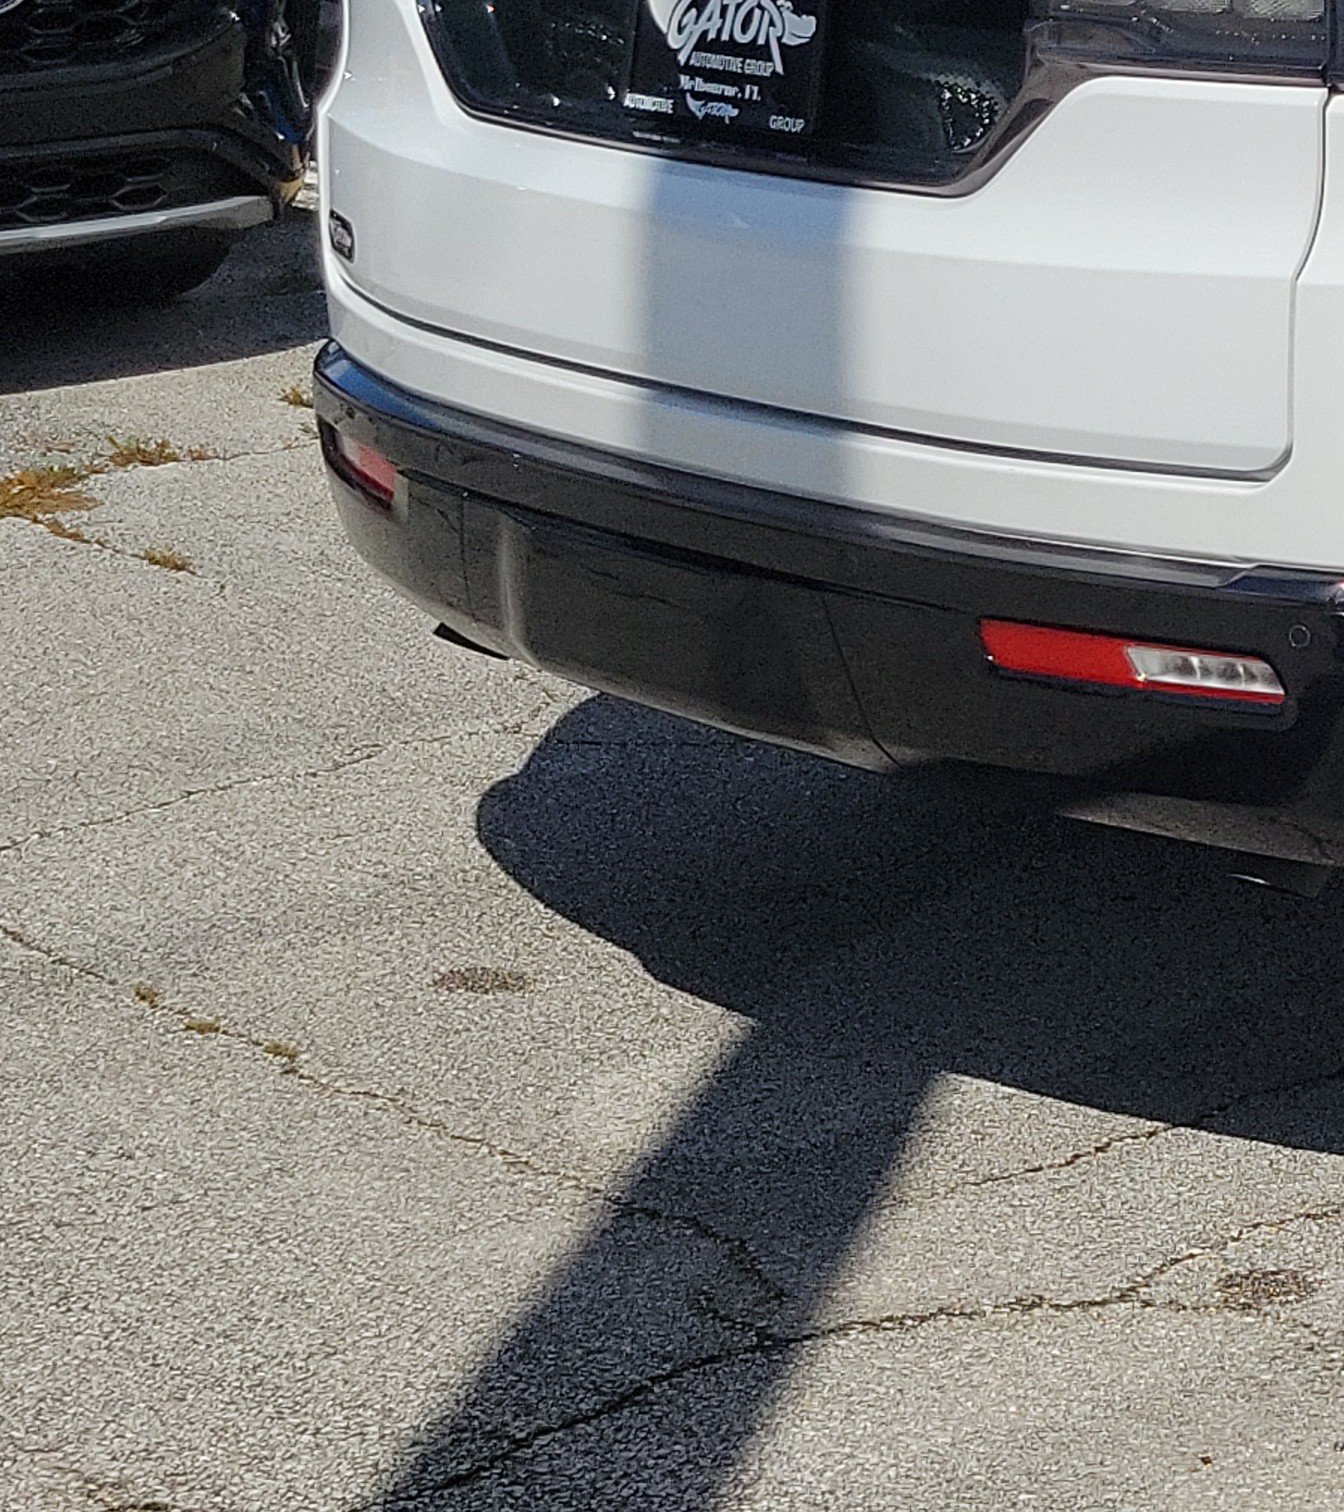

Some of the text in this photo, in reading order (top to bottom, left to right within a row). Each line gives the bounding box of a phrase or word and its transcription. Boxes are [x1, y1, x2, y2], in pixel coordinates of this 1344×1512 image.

[690, 51, 775, 77] AUTOMOTIVE GROUP
[769, 114, 805, 133] GROUP
